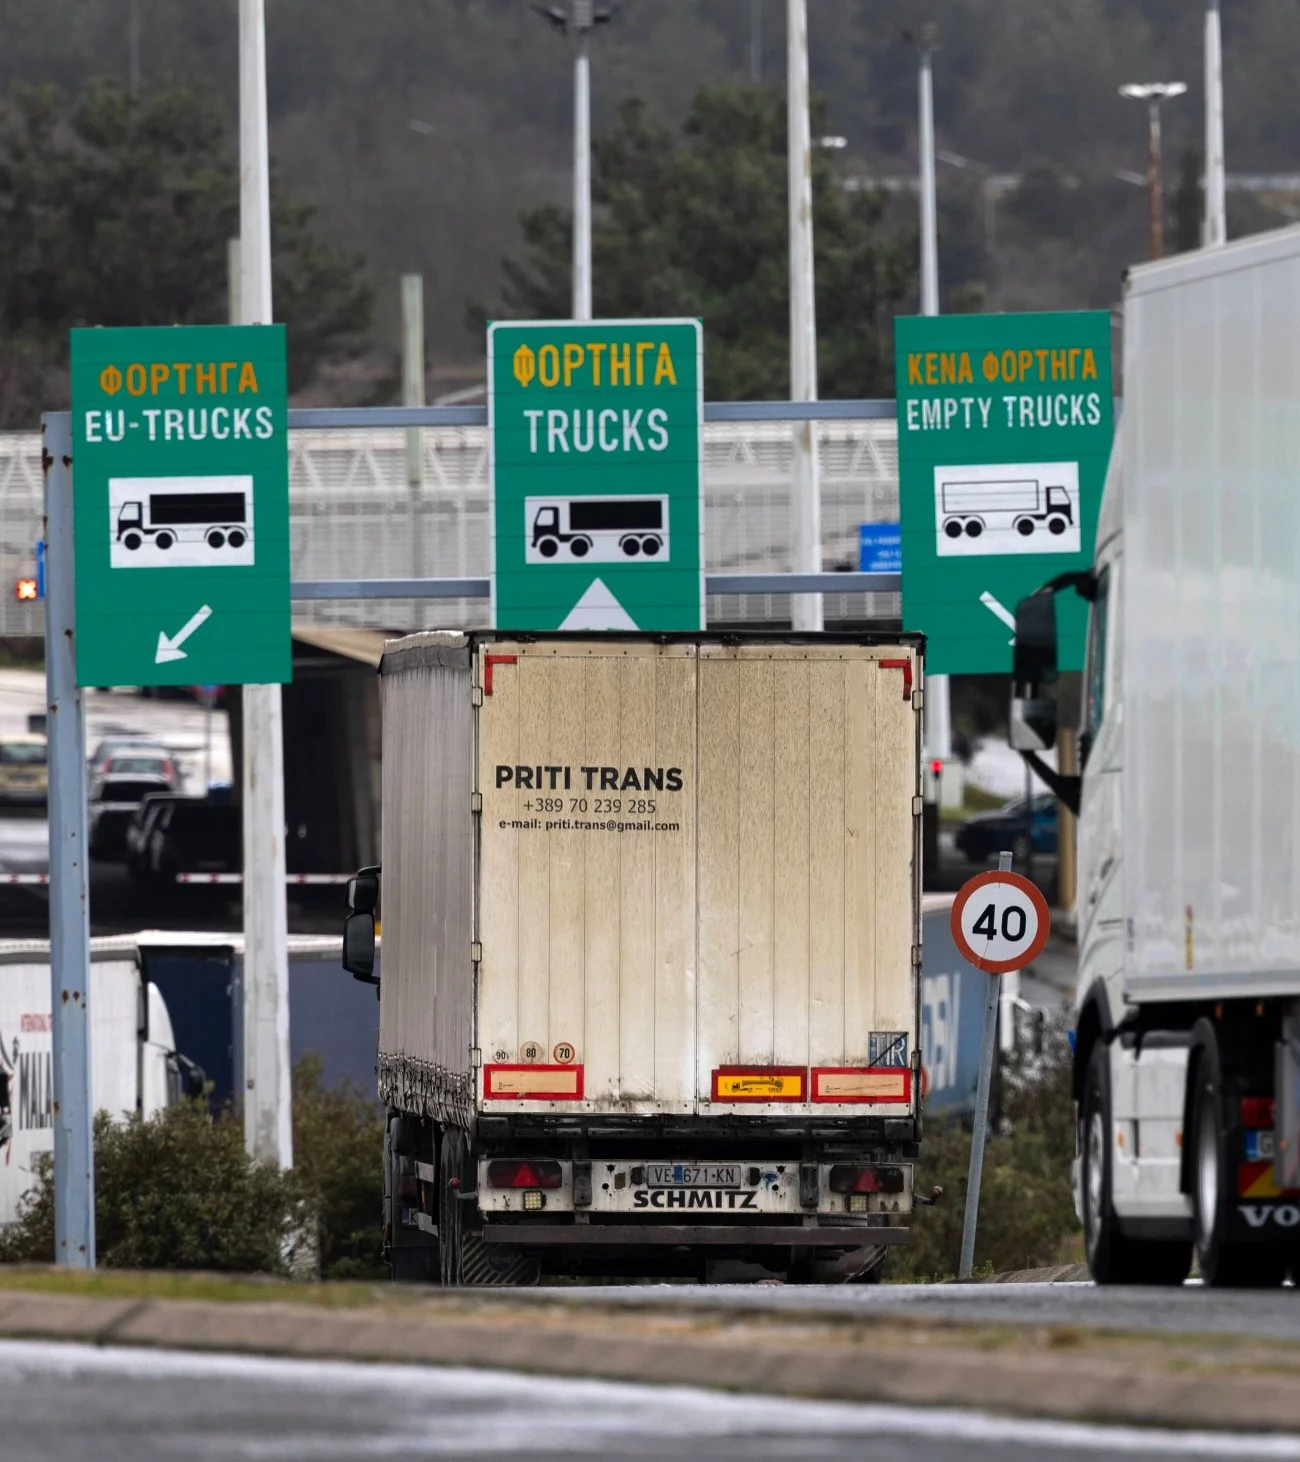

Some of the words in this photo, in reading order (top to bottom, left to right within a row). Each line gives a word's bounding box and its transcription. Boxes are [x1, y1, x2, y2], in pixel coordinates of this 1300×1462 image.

[99, 361, 259, 396] ΦΟΡΤΗΓΑ
[512, 342, 678, 388] ΦΟΡΤΗΓΑ
[907, 353, 973, 385] ΚΕΝΑ
[981, 348, 1098, 382] ΦΟΡΤΗΓΑ
[85, 406, 274, 443] EU-TRUCKS
[906, 397, 992, 431] EMPTY
[1003, 392, 1101, 427] TRUCKS
[523, 408, 669, 453] TRUCKS
[495, 765, 571, 790] PRITI
[580, 766, 684, 792] TRANS
[523, 797, 564, 813] +389
[569, 798, 588, 813] 70
[593, 798, 622, 814] 239
[627, 798, 657, 814] 285
[498, 818, 542, 830] e-mail:
[545, 819, 680, 833] priti.trans@gmail.com
[972, 903, 1027, 943] 40
[495, 1051, 506, 1060] 90
[526, 1047, 537, 1058] 80
[559, 1047, 571, 1059] 70
[871, 1033, 906, 1066] TIR
[633, 1190, 759, 1209] SCHMITZ
